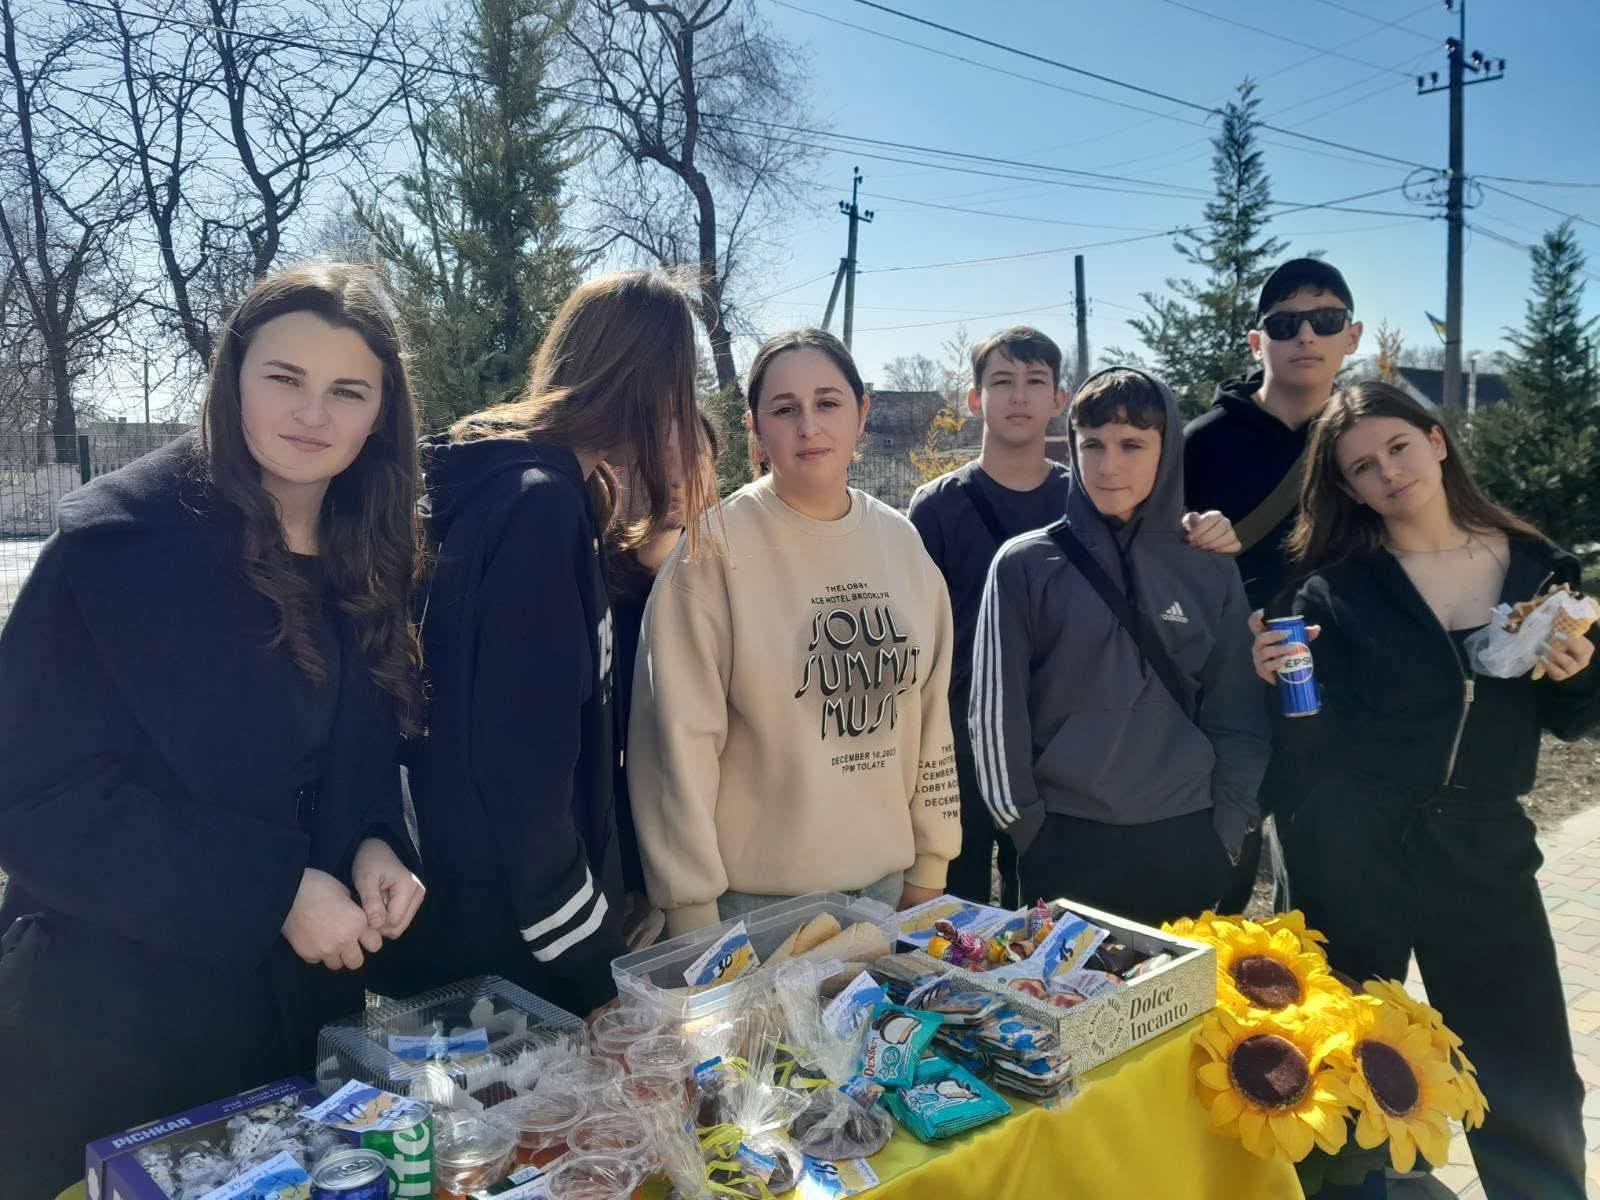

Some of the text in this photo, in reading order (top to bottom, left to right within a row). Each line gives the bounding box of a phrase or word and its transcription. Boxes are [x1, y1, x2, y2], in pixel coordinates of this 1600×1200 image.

[811, 592, 890, 605] ACE HOTEL BROOKLYN
[1160, 613, 1190, 624] adidas
[808, 605, 907, 651] SOUL
[1285, 655, 1312, 668] EPSI
[795, 647, 920, 698] SUMMIT
[821, 690, 902, 740] MUSI
[831, 752, 870, 766] DECEMBER
[842, 765, 855, 774] 7PM
[915, 782, 946, 793] LOBBY
[942, 810, 959, 819] 7PM
[1129, 985, 1175, 1021] Dolce
[1130, 1002, 1188, 1041] Incanto
